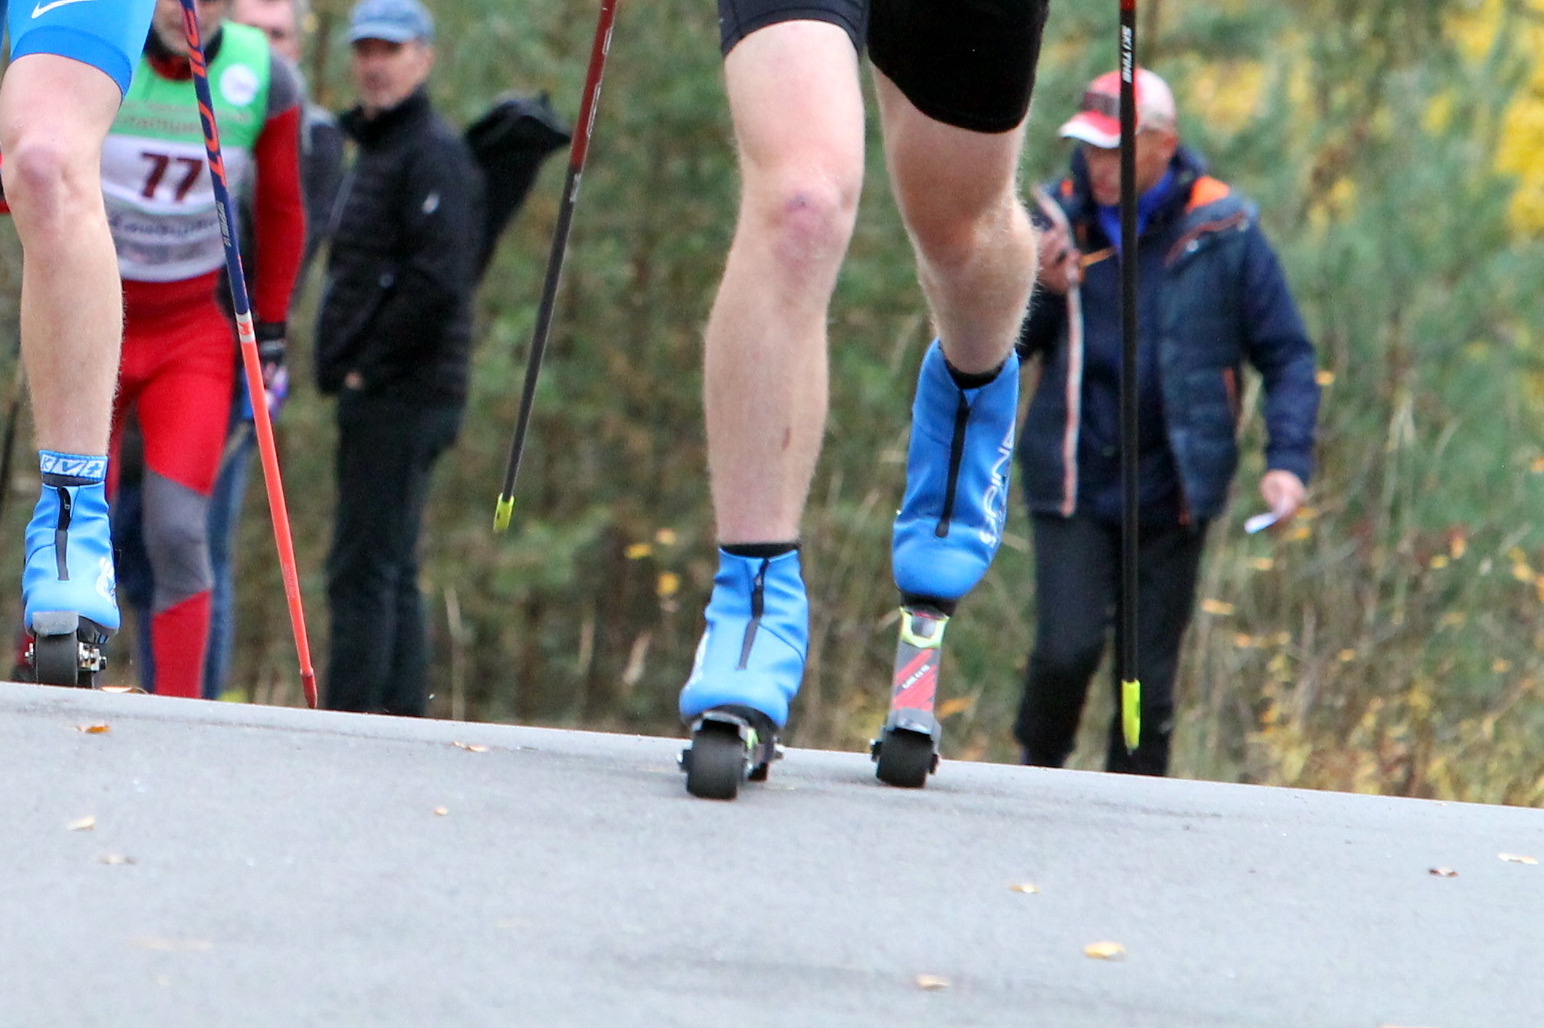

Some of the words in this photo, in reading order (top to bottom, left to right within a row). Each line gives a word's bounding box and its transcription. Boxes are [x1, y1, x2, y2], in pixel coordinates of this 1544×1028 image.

[1121, 25, 1133, 51] SKI
[1121, 51, 1132, 84] TIME
[141, 152, 203, 203] 77
